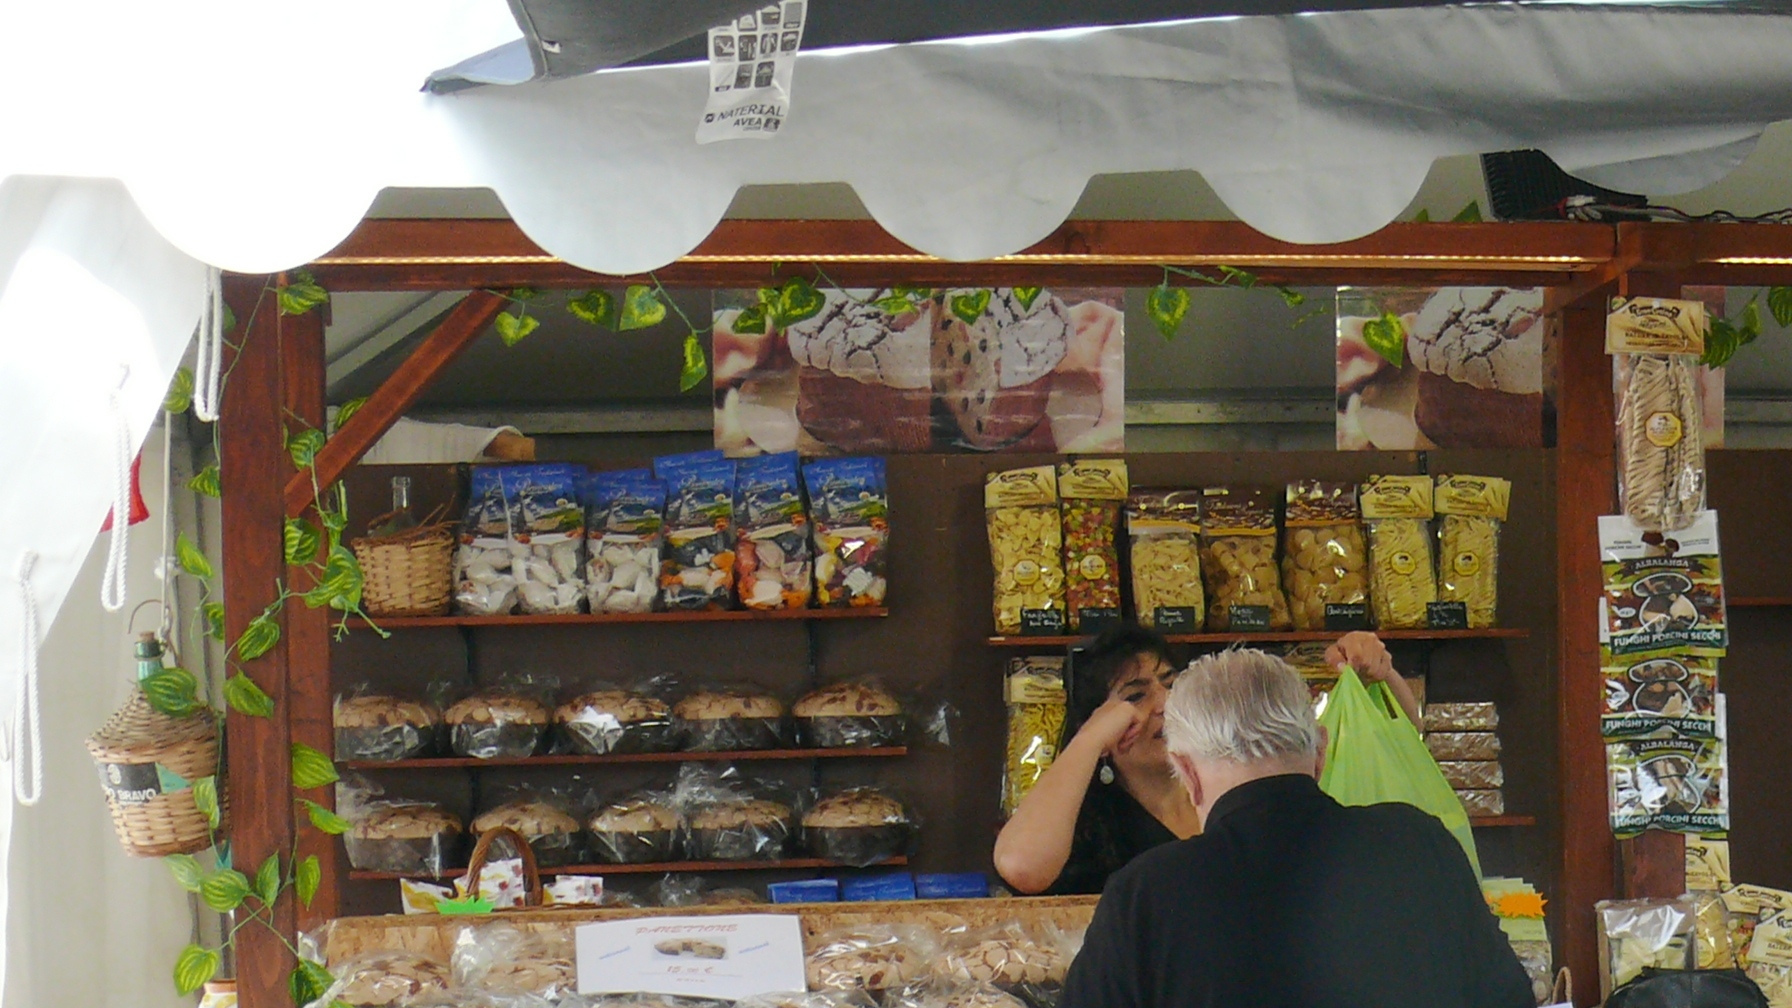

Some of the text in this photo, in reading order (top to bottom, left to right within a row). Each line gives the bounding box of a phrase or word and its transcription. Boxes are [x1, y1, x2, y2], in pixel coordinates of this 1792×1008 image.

[717, 104, 784, 121] NATERIAL
[733, 117, 762, 127] AVEA
[1614, 631, 1721, 646] FUNGHI PORCINI SECCHI
[1605, 719, 1642, 729] FUNGHI
[1682, 721, 1712, 731] SECCHI
[117, 788, 156, 800] BRAVO
